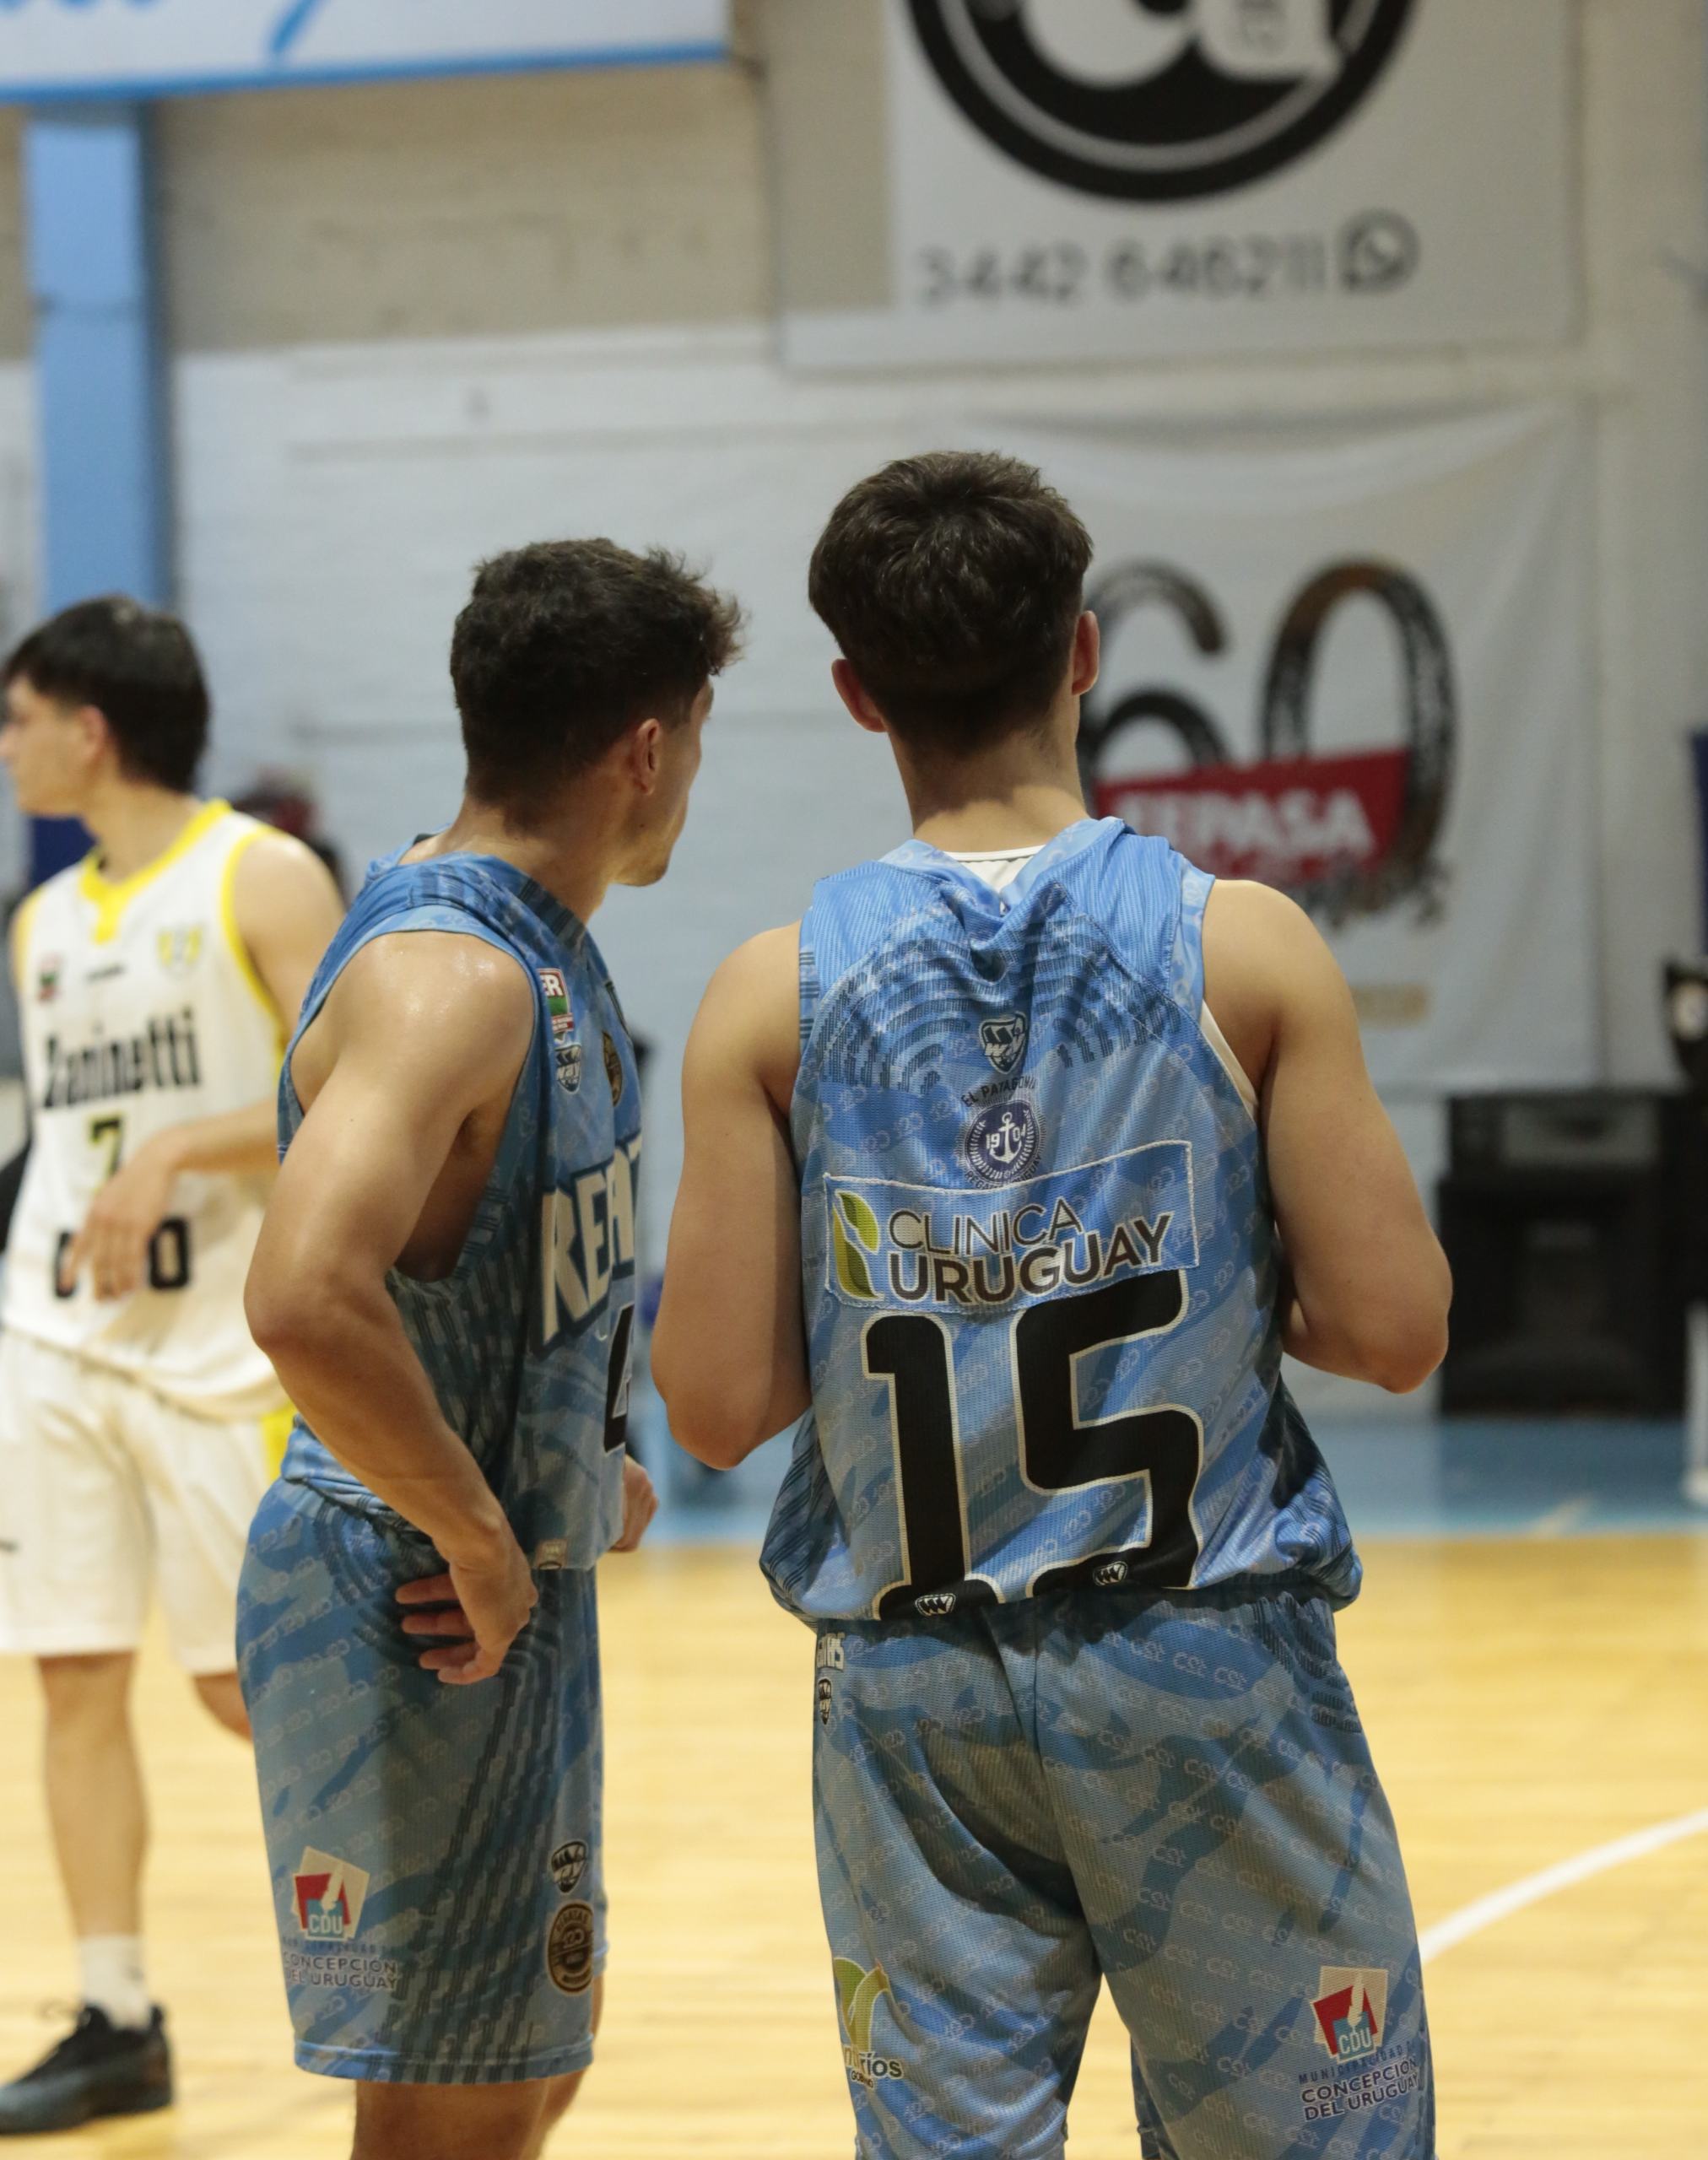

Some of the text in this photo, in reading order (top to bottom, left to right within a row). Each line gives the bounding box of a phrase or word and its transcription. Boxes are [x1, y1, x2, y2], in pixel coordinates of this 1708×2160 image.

[986, 1132, 1001, 1150] 19
[889, 1197, 1084, 1256] CLINICA
[890, 1213, 1173, 1303] URUGUAY
[862, 1269, 1204, 1621] 15
[309, 1914, 343, 1935] CDU
[310, 1974, 397, 1989] URUGUAY
[1338, 2026, 1373, 2055] CDU
[1305, 2071, 1418, 2121] DEL URUGUAY
